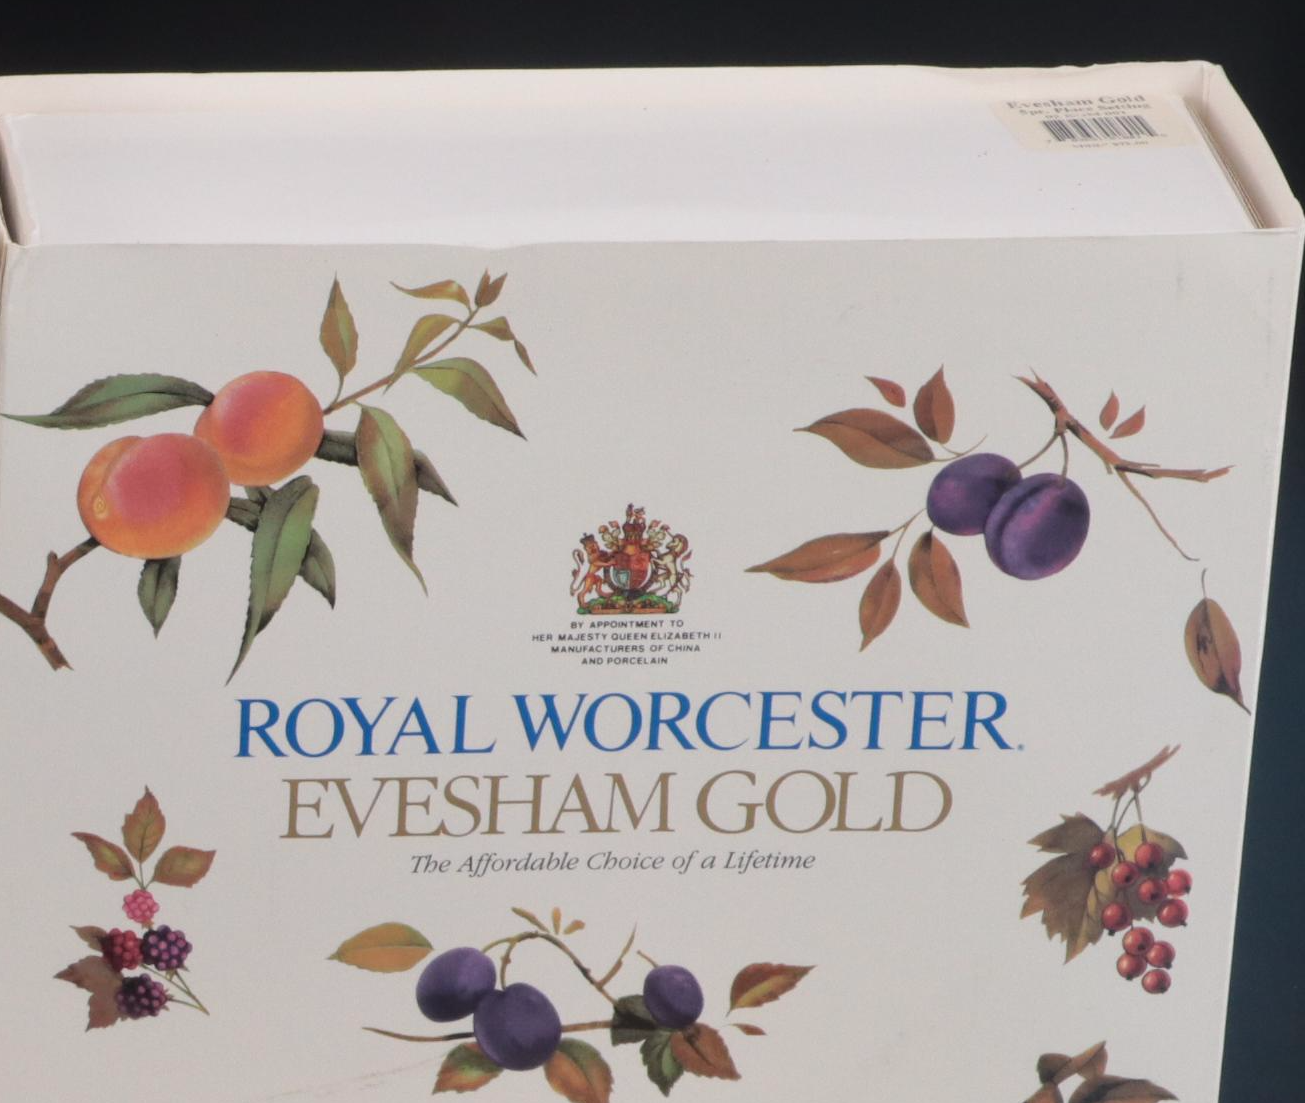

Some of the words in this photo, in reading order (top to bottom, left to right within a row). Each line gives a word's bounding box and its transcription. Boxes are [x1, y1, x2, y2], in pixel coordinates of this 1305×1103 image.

[1097, 94, 1146, 104] Gold
[236, 695, 494, 758] ROYAL
[279, 772, 676, 840] EVESHAM
[696, 770, 953, 835] GOLD
[411, 854, 452, 874] The
[456, 851, 580, 878] Affordable
[586, 850, 665, 870] Choice
[671, 850, 700, 875] of
[700, 855, 717, 870] a
[723, 849, 816, 875] Lifetime
